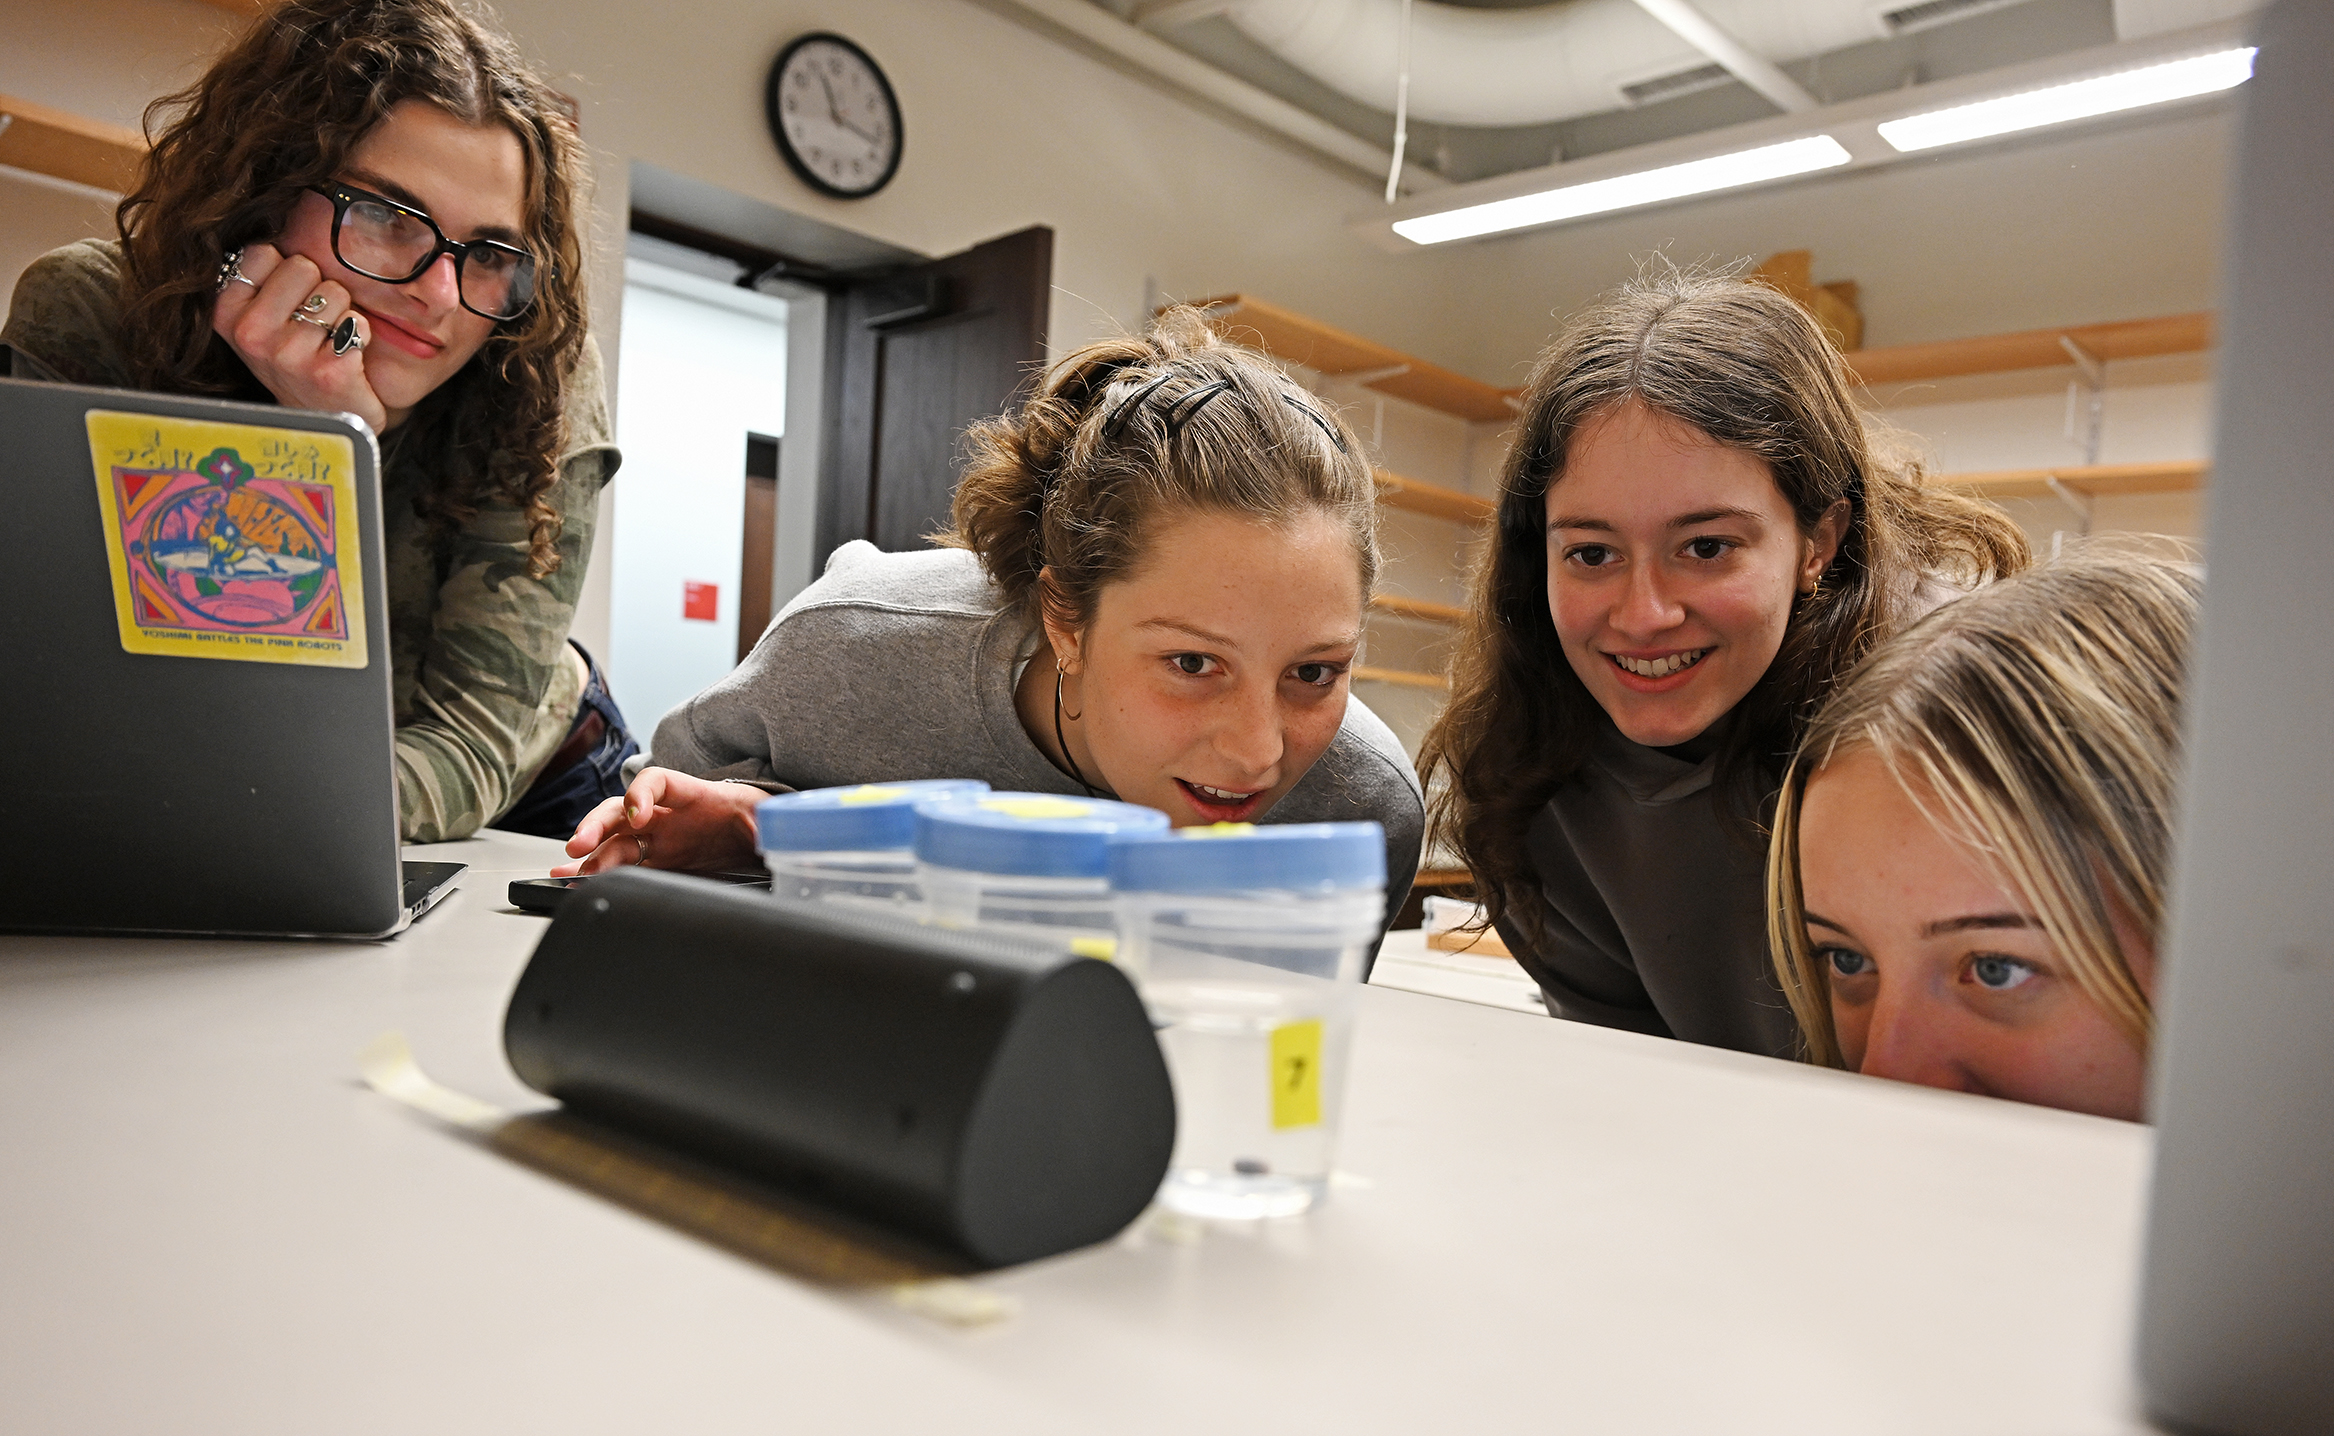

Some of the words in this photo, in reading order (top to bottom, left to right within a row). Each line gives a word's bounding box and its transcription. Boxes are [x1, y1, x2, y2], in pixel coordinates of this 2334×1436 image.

[142, 629, 193, 641] YOSHIMI
[196, 633, 240, 644] BATTLES
[244, 636, 263, 645] THE
[267, 638, 294, 647] PINK
[297, 640, 343, 651] ROBOTS
